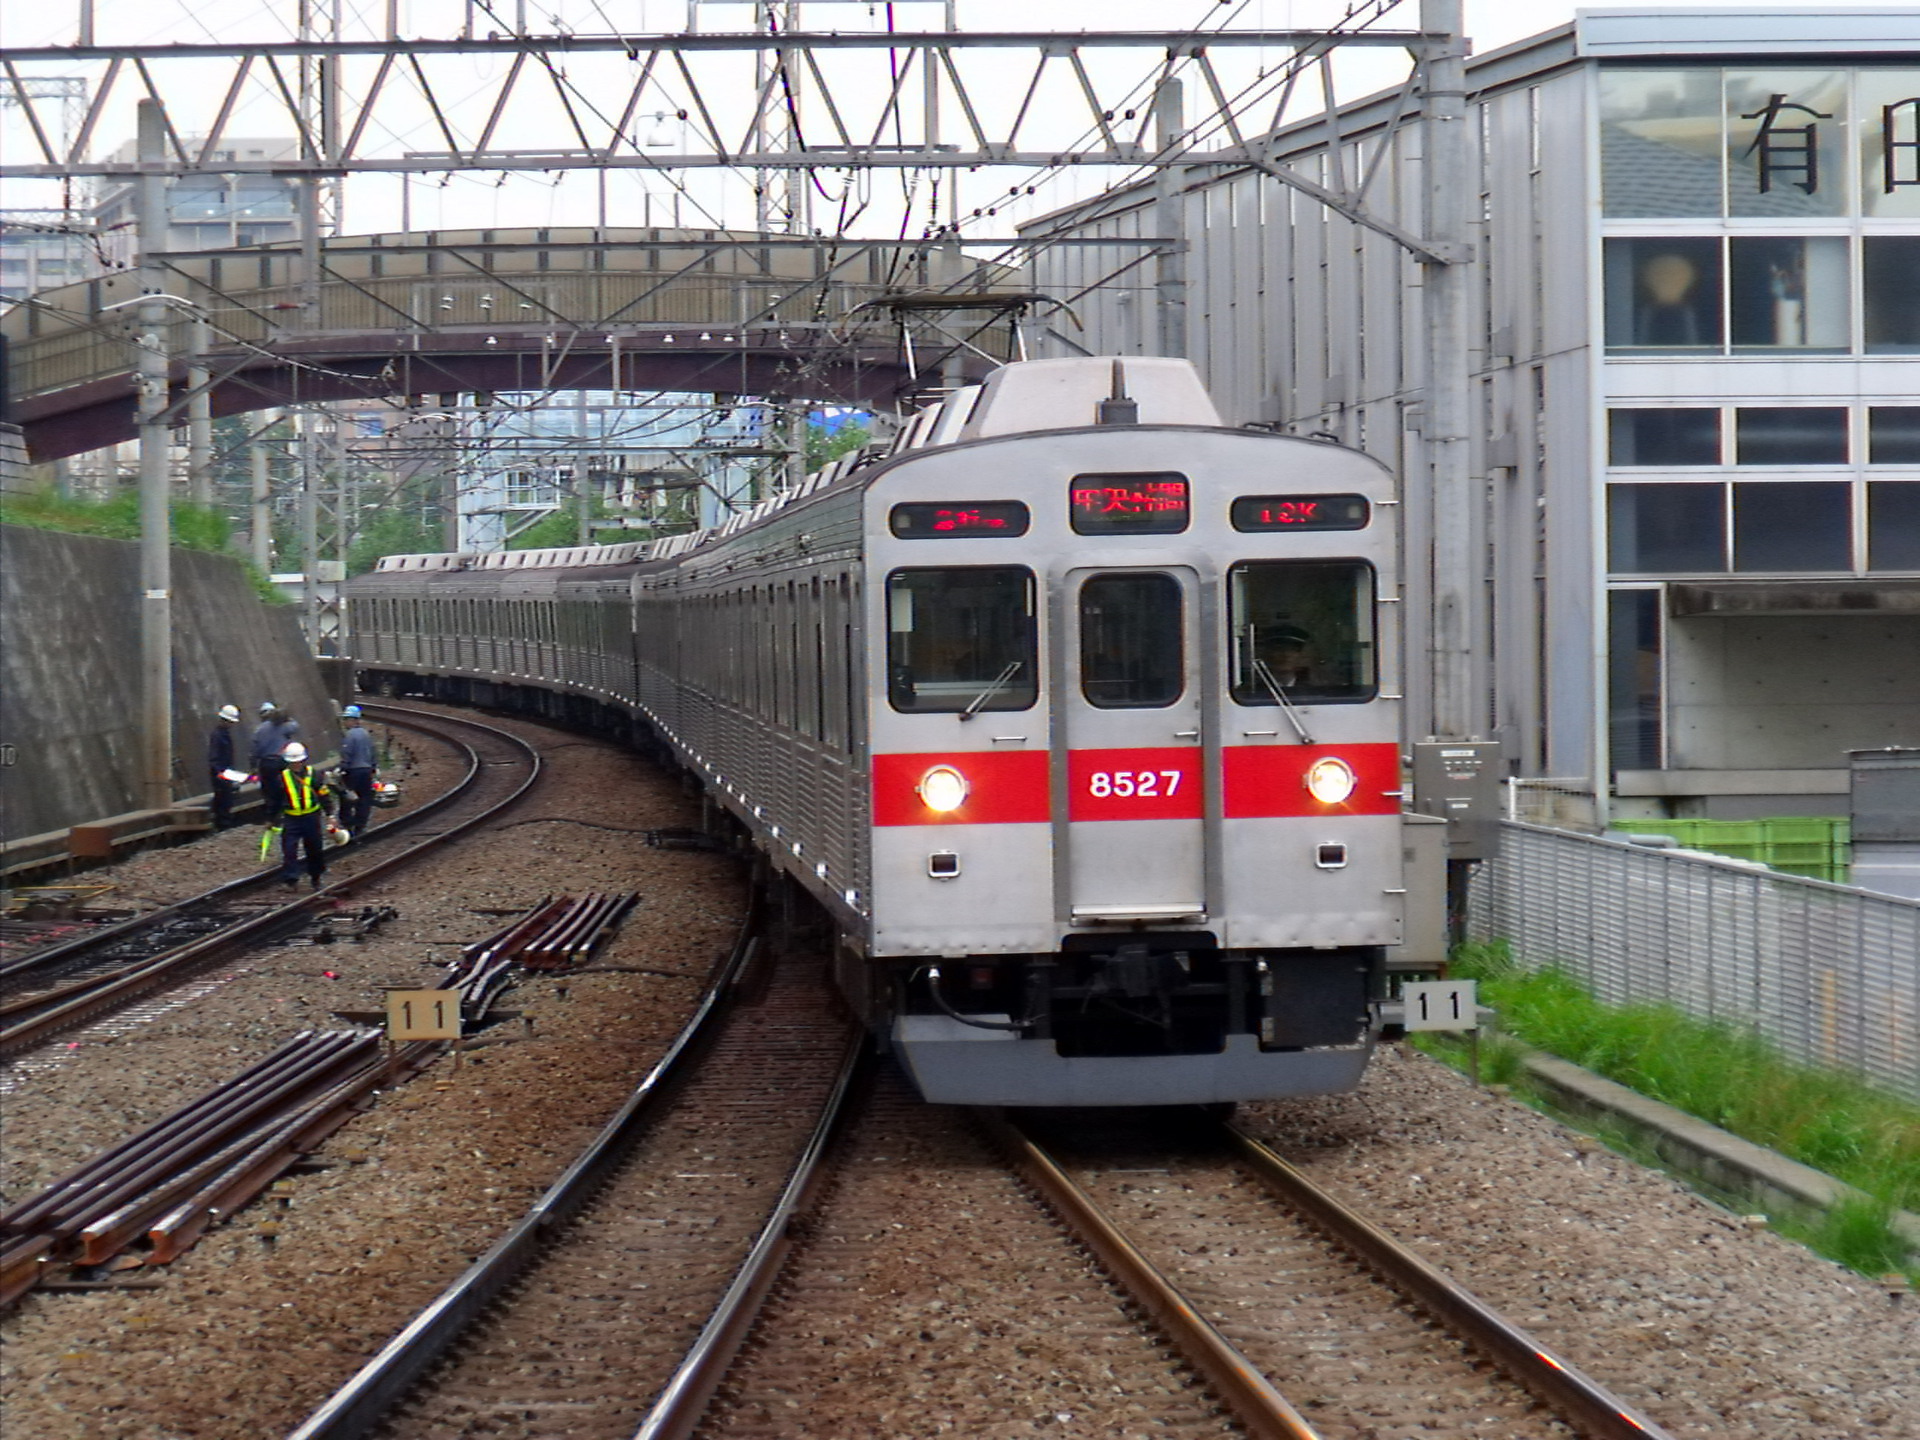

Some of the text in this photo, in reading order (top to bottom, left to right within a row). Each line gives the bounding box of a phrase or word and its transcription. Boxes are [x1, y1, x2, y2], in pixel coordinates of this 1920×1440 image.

[1089, 770, 1182, 797] 8527
[402, 1000, 443, 1029] 11
[1418, 992, 1458, 1020] 11
